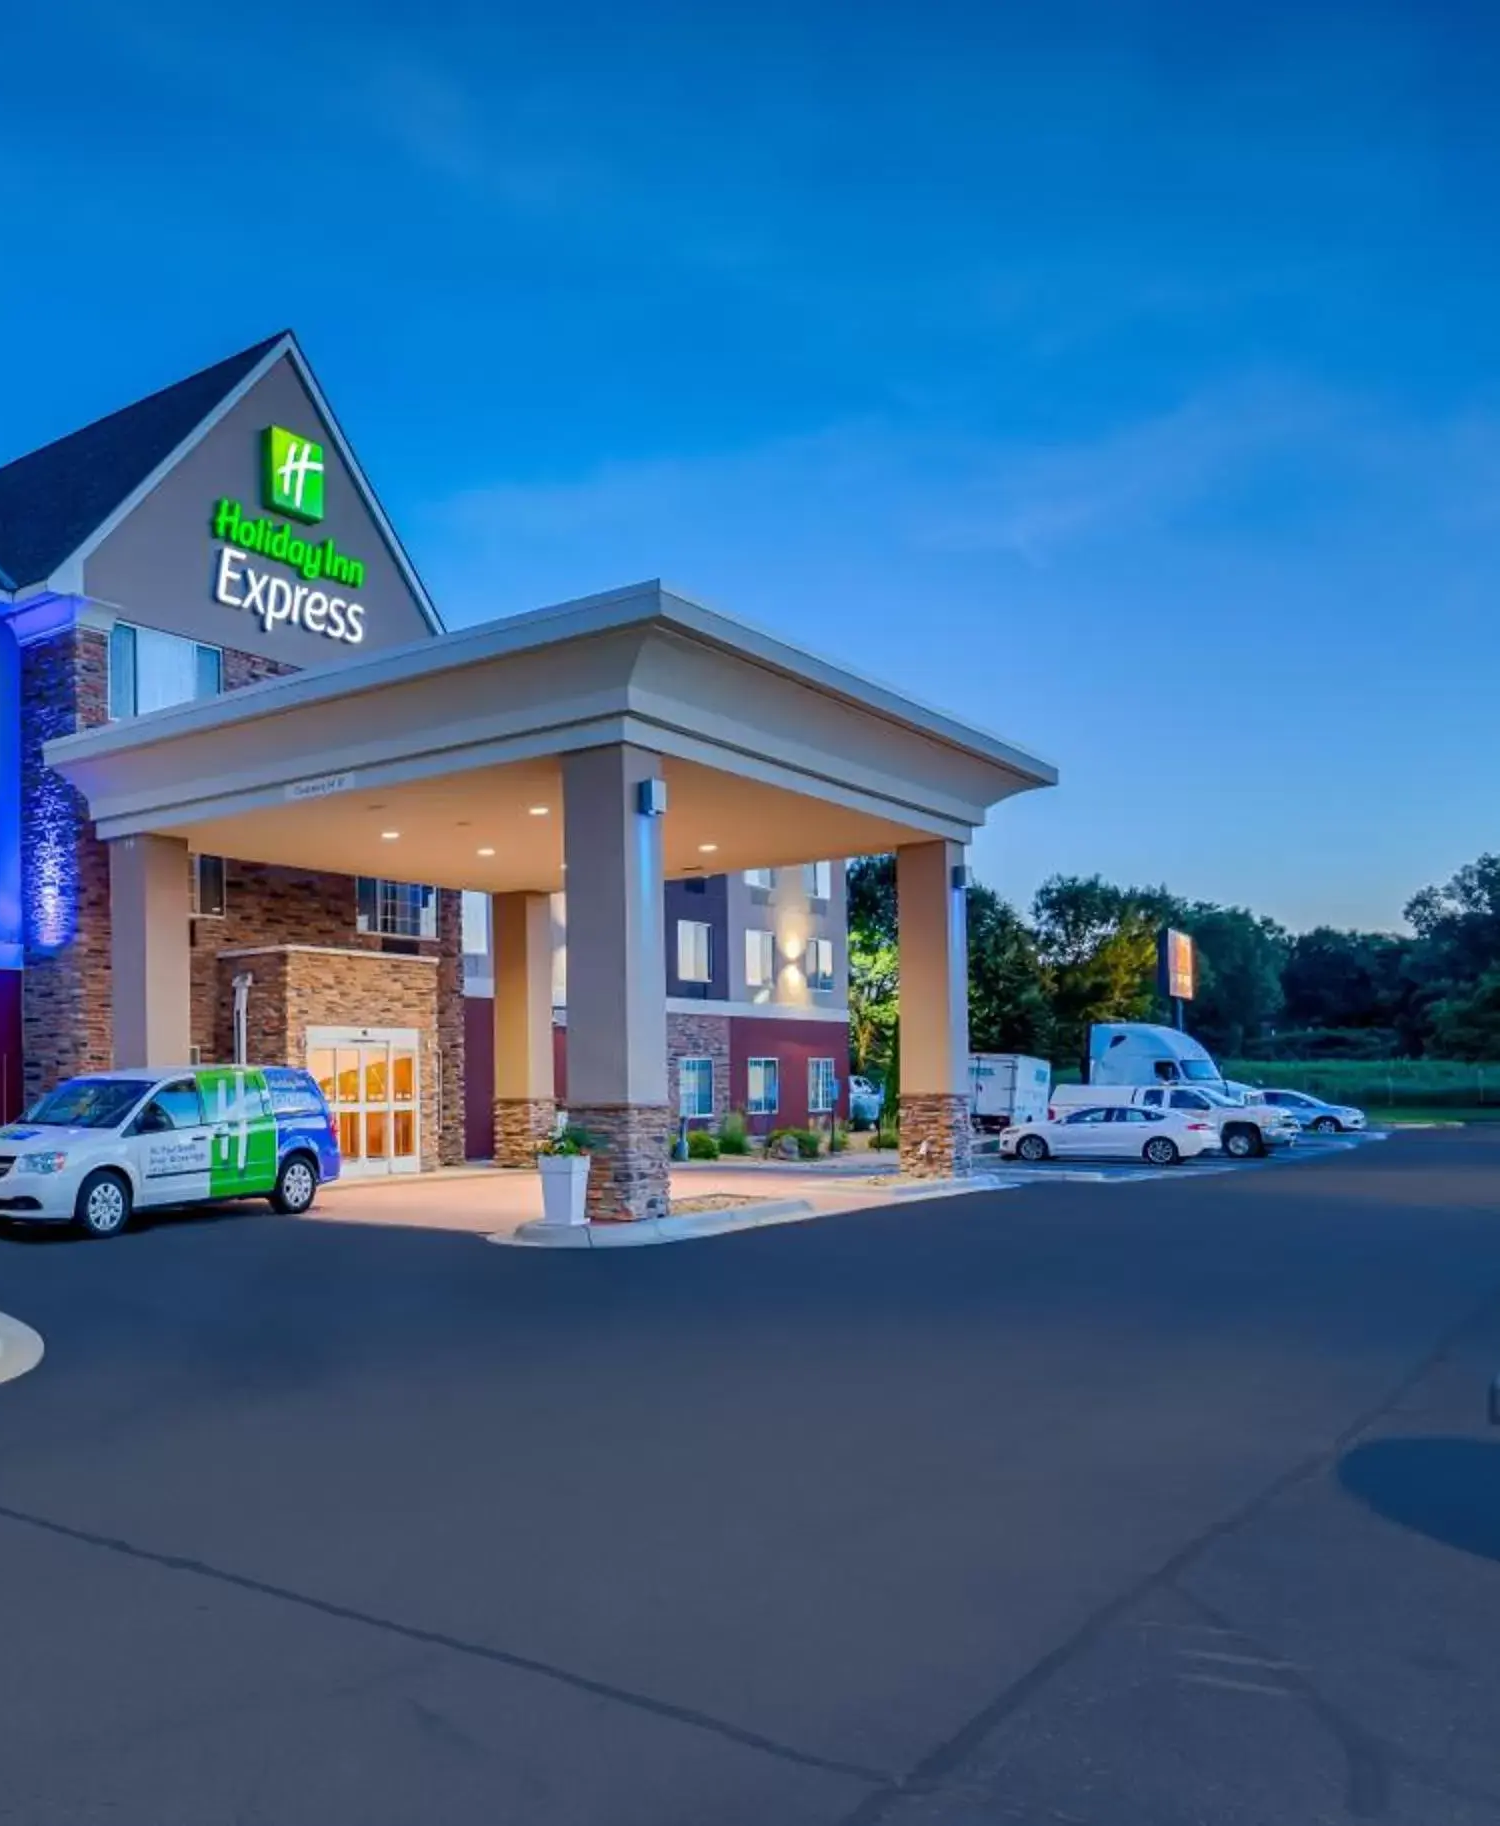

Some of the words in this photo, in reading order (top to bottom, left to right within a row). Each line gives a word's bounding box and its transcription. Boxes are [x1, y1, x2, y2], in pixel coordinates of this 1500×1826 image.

[216, 499, 322, 578] Holiday
[323, 537, 365, 588] Inn
[217, 547, 365, 643] Express
